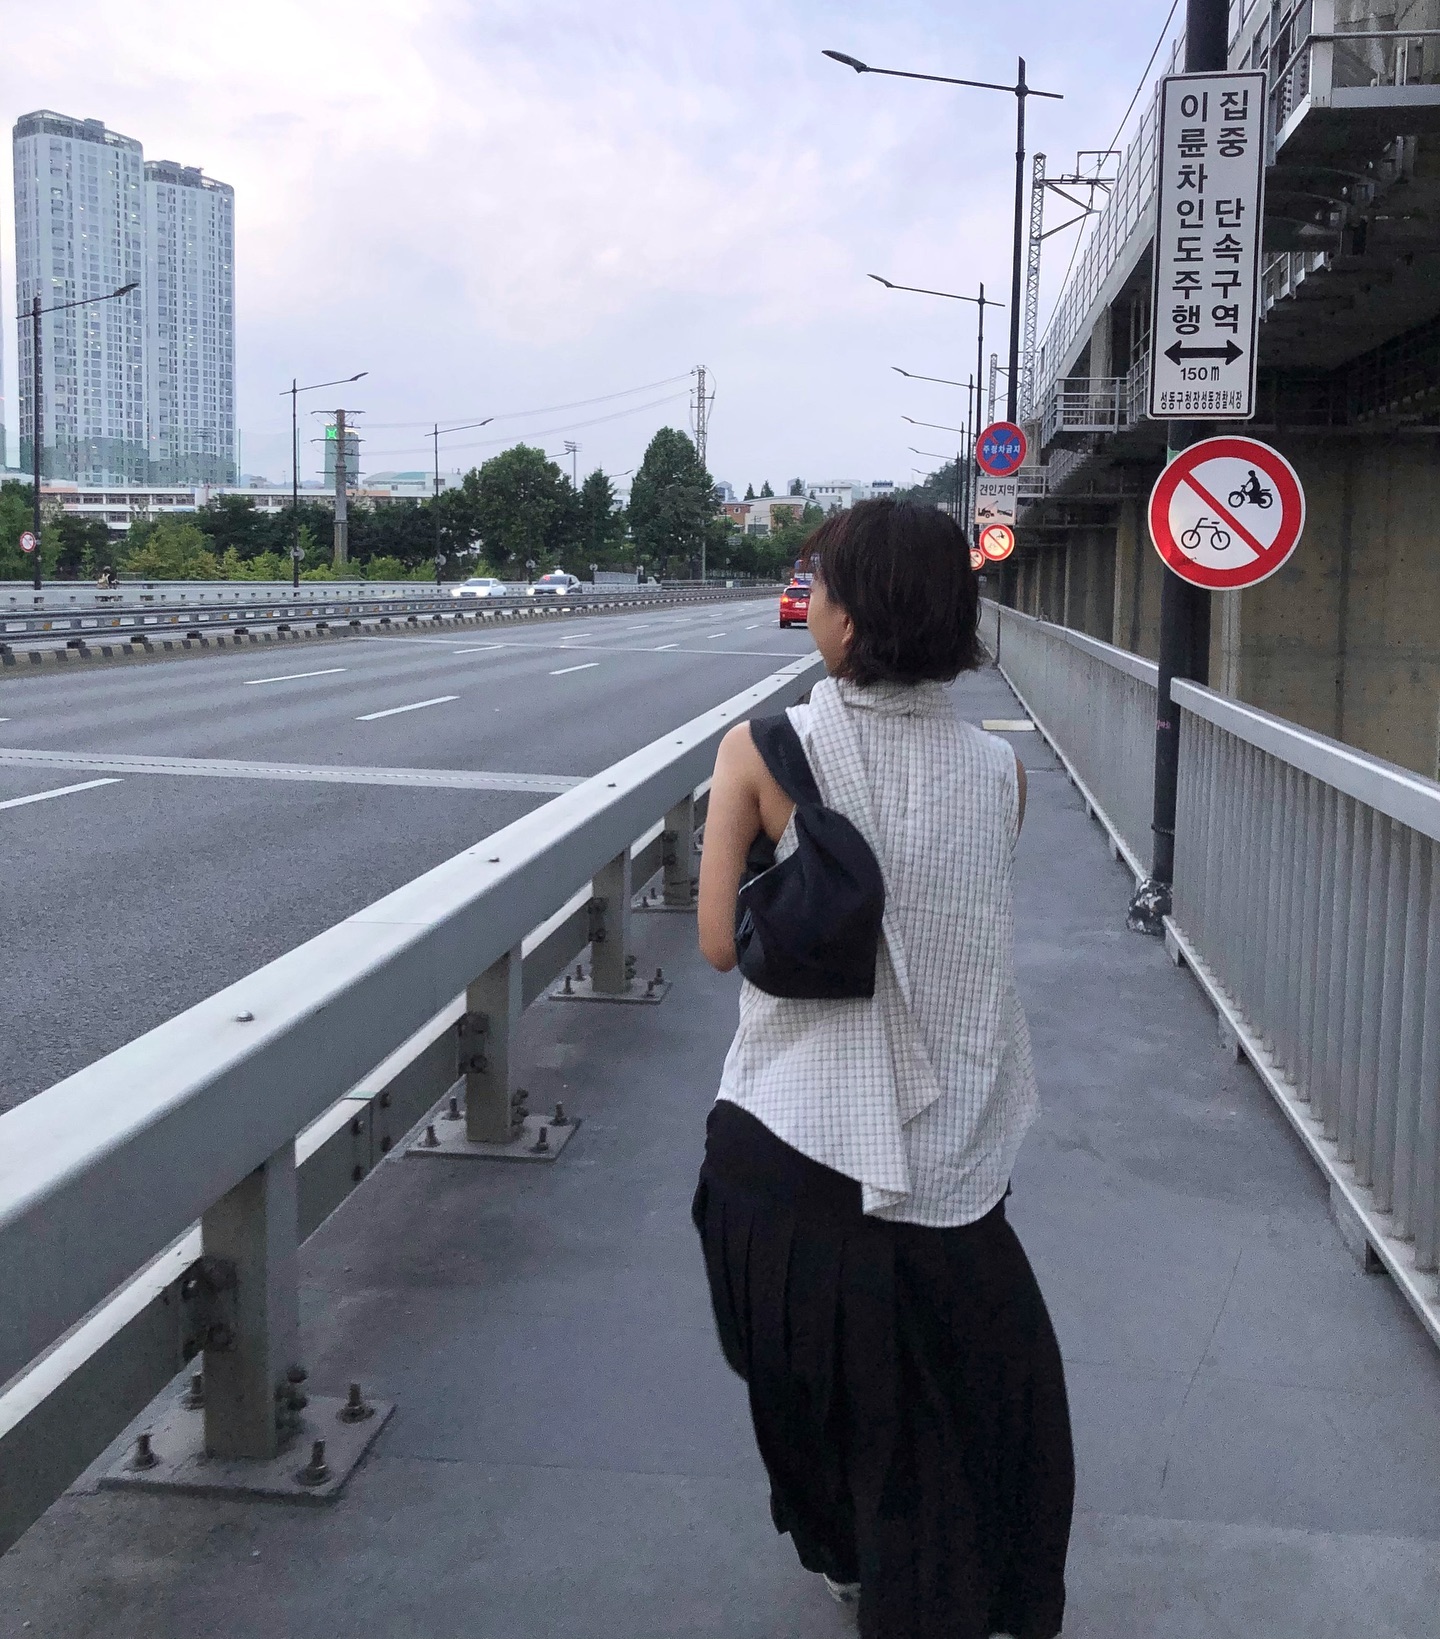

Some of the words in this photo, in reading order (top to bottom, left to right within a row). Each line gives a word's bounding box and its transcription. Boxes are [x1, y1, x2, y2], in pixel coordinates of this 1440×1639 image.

[1217, 89, 1249, 158] 집중
[1172, 91, 1209, 335] 이륜차인도주행
[1211, 197, 1245, 334] 단속구역
[983, 444, 1020, 454] 주정차금지
[979, 484, 1015, 497] 견인지역
